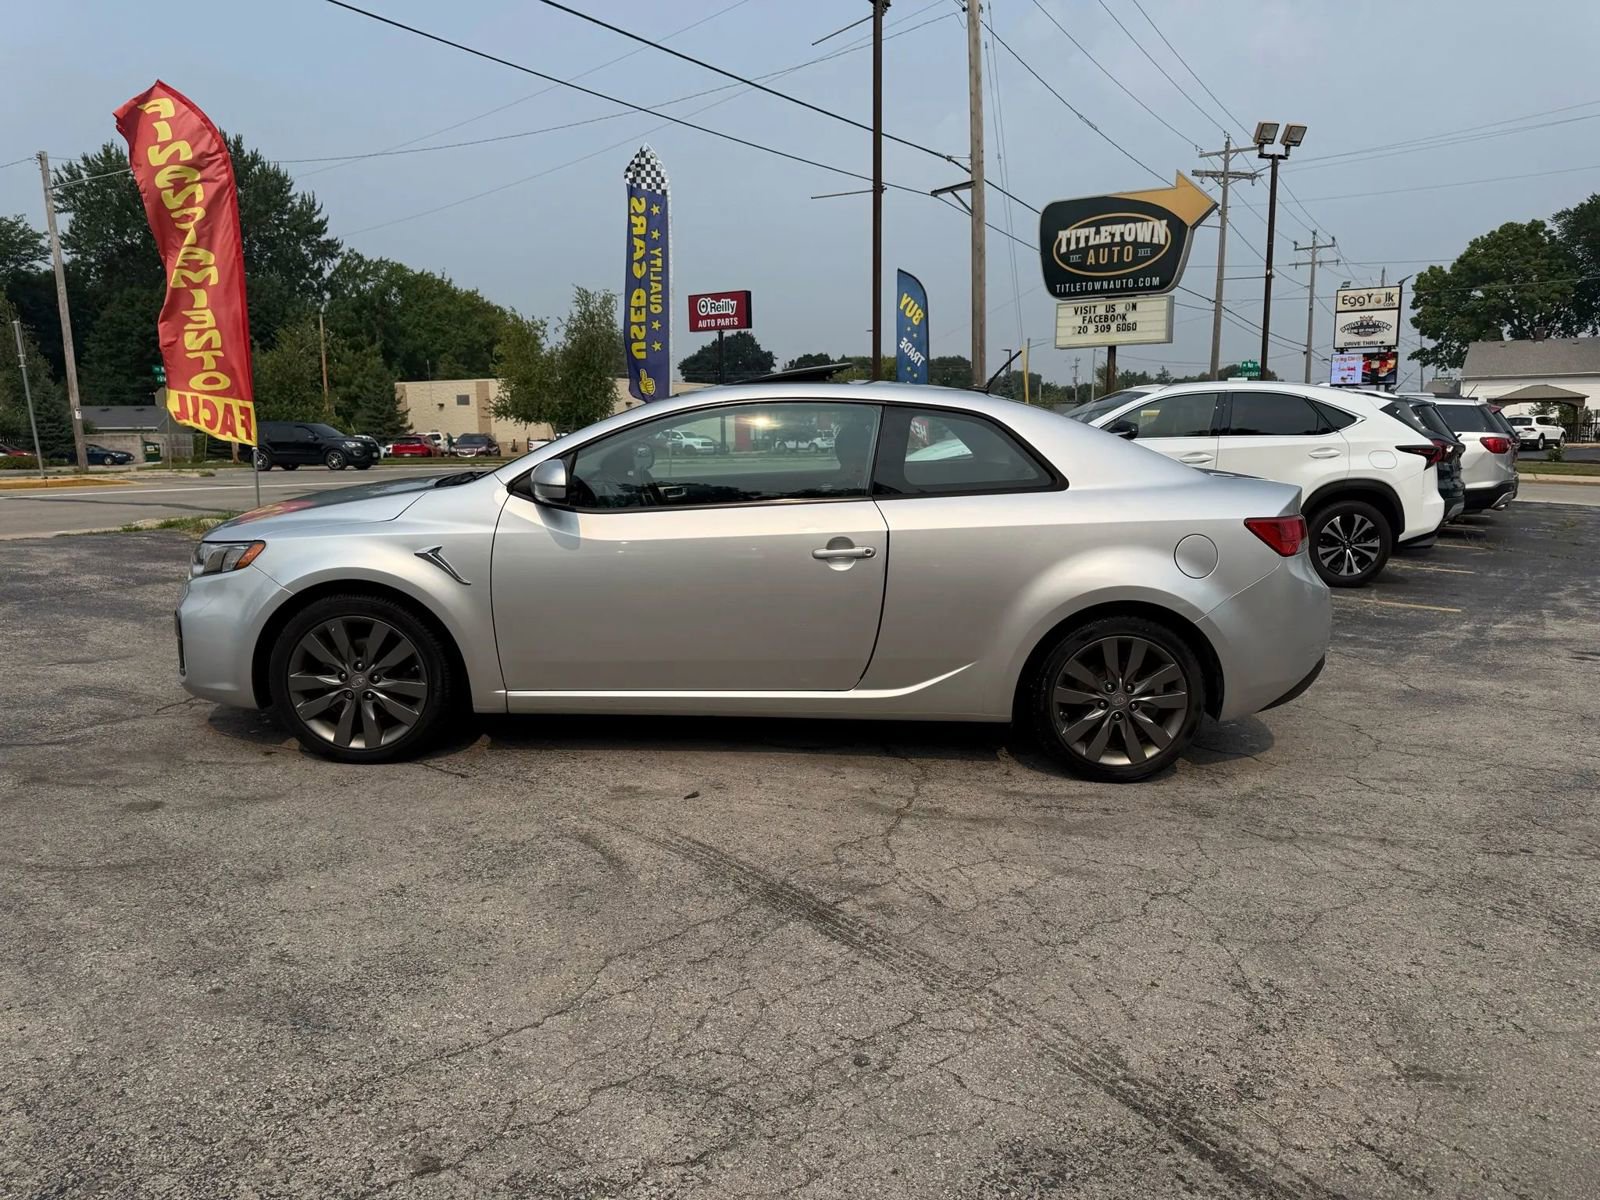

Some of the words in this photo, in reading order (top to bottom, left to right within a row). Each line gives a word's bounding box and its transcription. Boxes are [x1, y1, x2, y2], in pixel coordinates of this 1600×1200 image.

[1057, 219, 1168, 254] TITLETOWN
[1086, 245, 1133, 266] AUTO
[1056, 277, 1160, 293] TITLETOWNAUTO.COM
[697, 297, 737, 316] O'Reilly
[1073, 305, 1097, 316] VISIT
[1105, 304, 1116, 313] US
[1125, 302, 1137, 312] ON
[698, 319, 716, 328] AUTO
[716, 317, 739, 326] PARTS
[1082, 313, 1127, 325] FACEBOOK
[1072, 325, 1089, 336] 20
[1094, 324, 1111, 334] 309
